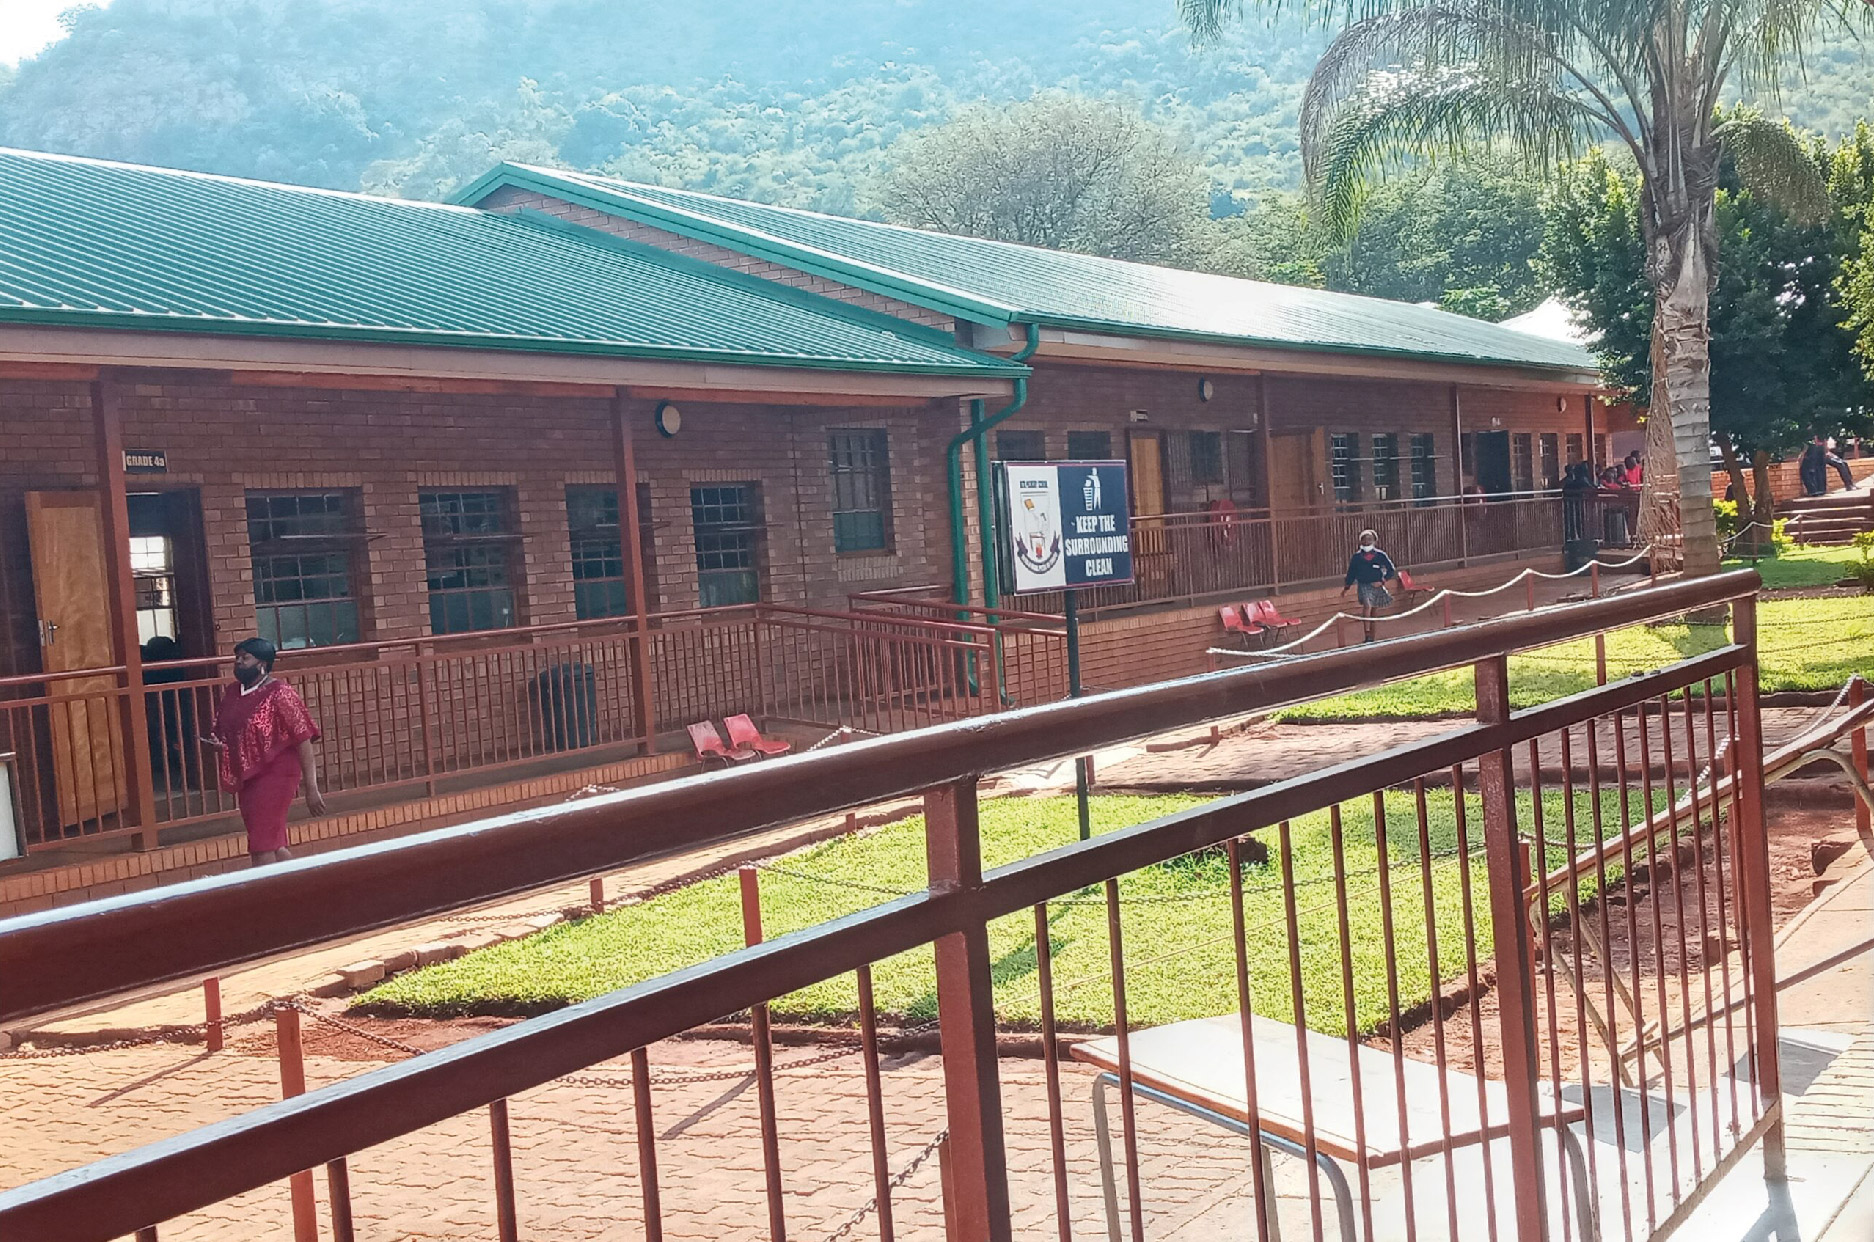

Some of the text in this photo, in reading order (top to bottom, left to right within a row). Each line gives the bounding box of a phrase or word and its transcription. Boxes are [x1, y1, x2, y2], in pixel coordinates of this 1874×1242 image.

[126, 455, 153, 467] GRADE
[1076, 514, 1116, 533] KEEP THE
[1065, 535, 1129, 556] SURROUNDING
[1086, 558, 1113, 577] CLEAN
